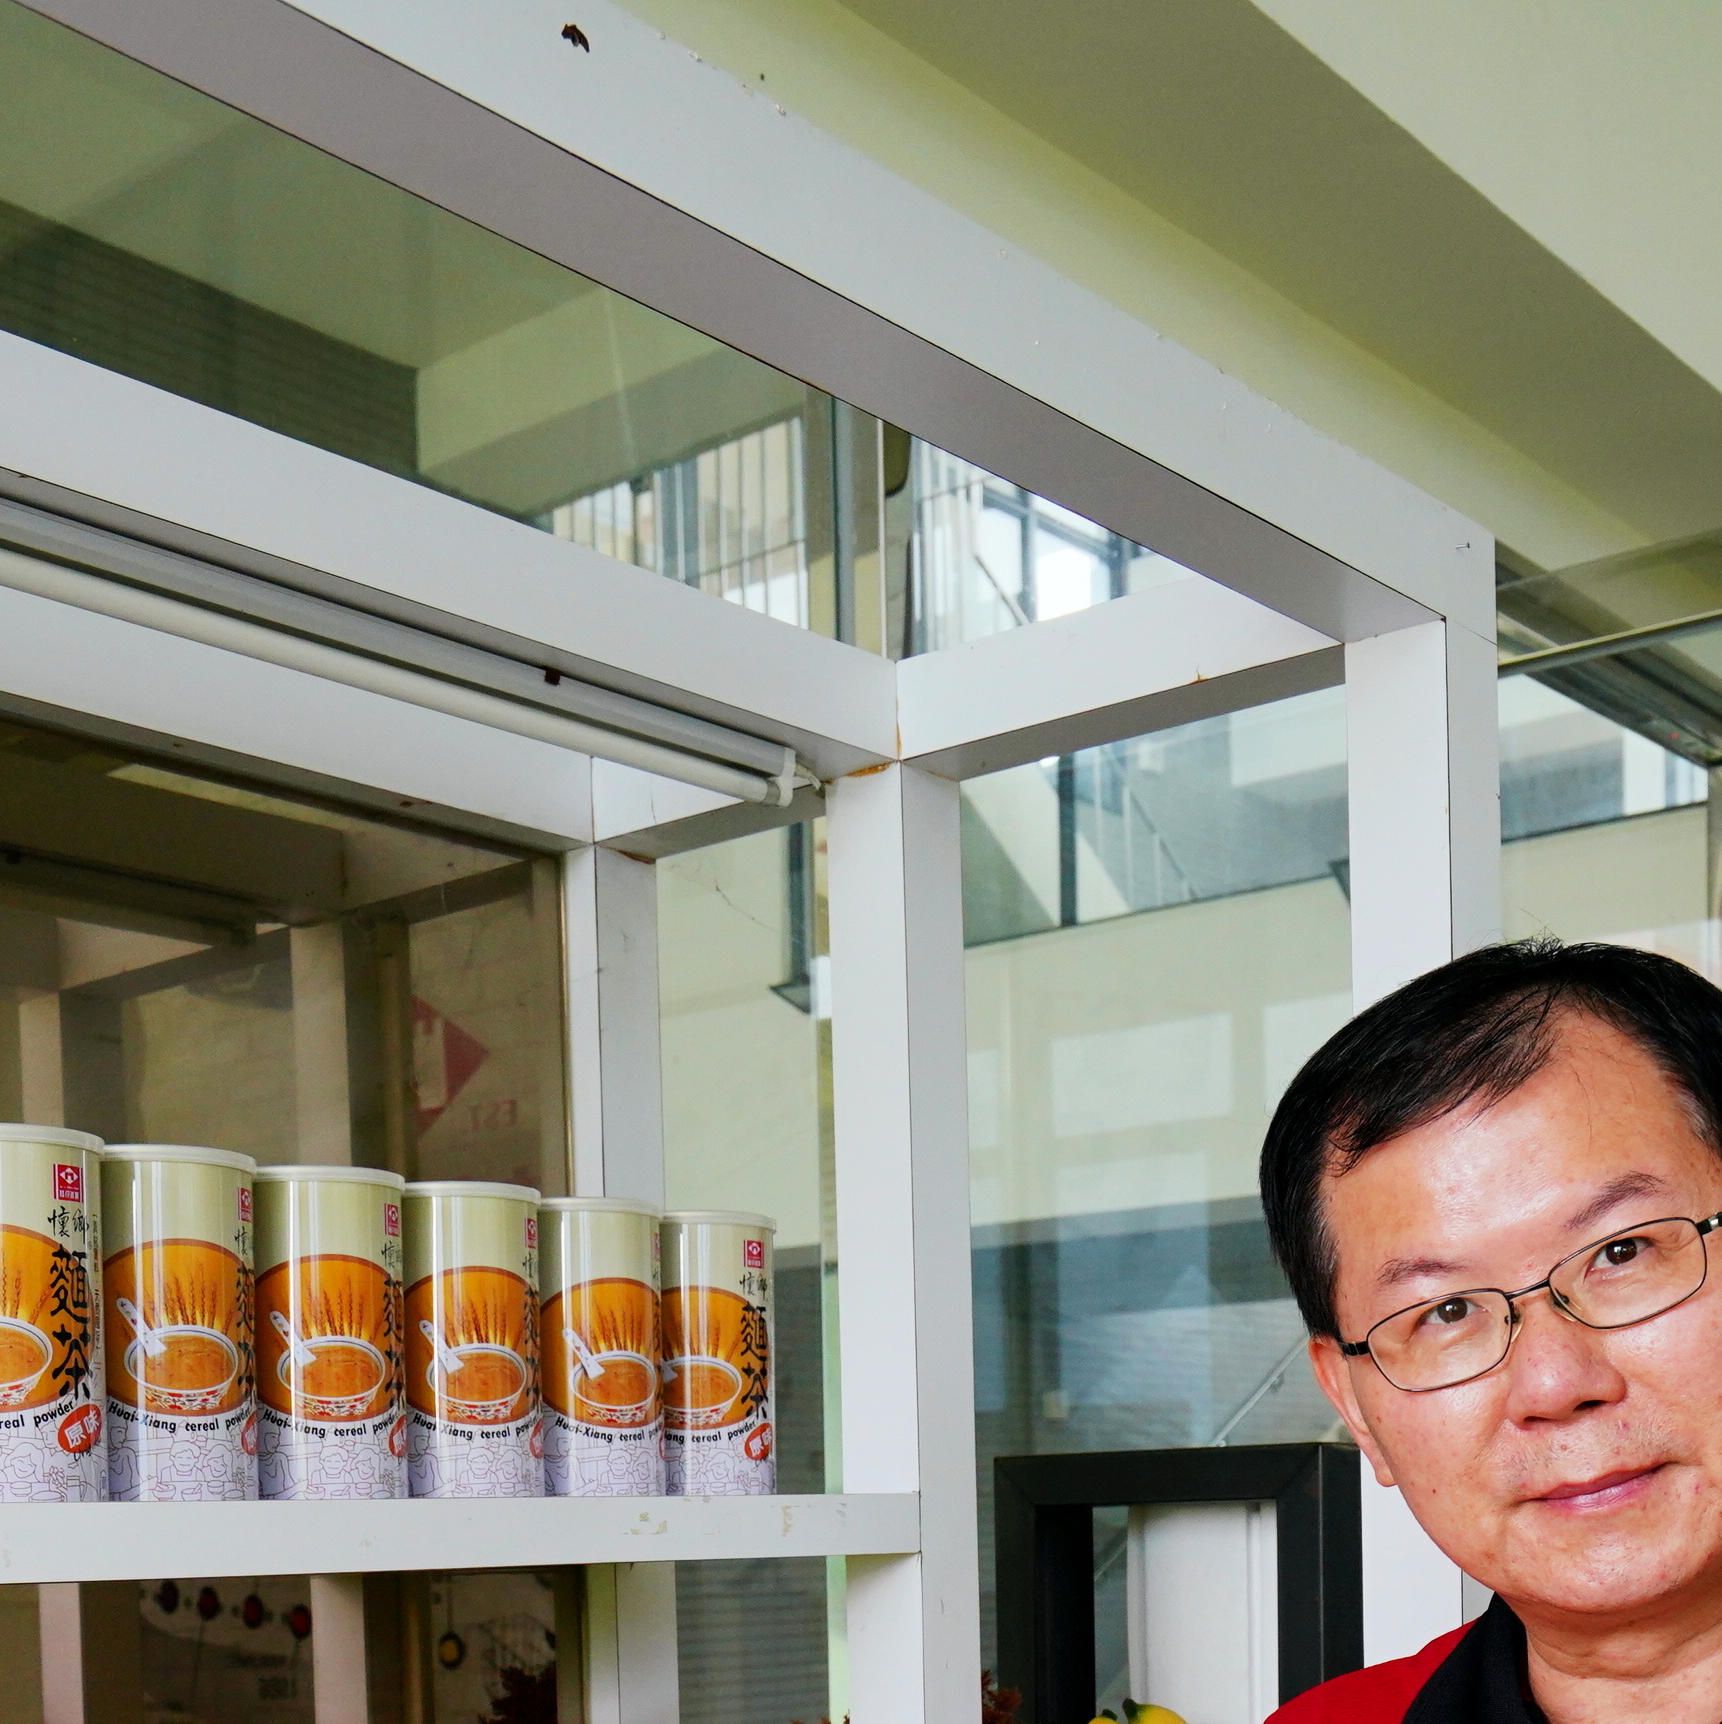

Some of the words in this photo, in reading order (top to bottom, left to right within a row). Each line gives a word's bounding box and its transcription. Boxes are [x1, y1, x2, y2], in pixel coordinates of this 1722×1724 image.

[50, 1244, 92, 1400] 麵茶
[34, 1401, 74, 1426] powder
[109, 1403, 177, 1433] Huai-Xiang
[185, 1416, 219, 1431] cereal
[64, 1412, 101, 1449] 原味
[334, 1424, 367, 1437] cereal
[481, 1425, 510, 1439] cereal
[692, 1430, 721, 1442] cereal
[728, 1420, 756, 1441] powder
